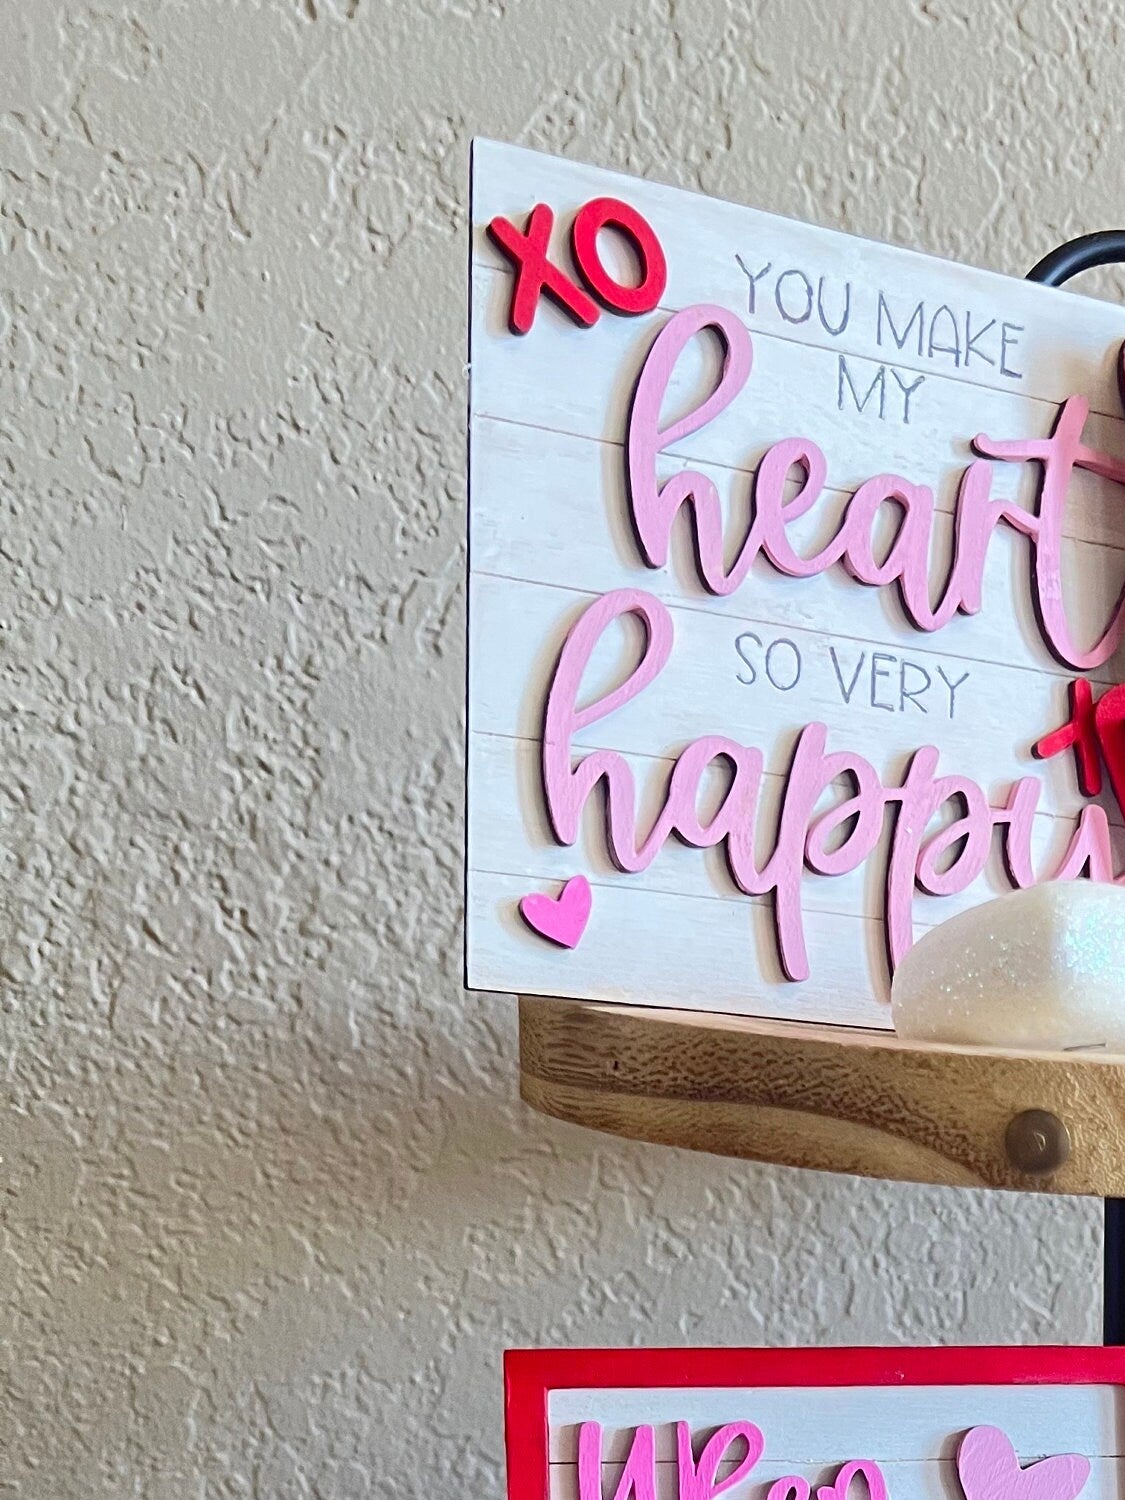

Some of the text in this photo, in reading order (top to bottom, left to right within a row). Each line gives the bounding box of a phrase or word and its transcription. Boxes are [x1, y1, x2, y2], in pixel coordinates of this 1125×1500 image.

[486, 197, 667, 335] XO
[735, 253, 1026, 378] YOU MAKE
[837, 355, 926, 423] MY
[735, 631, 970, 719] SO VERY
